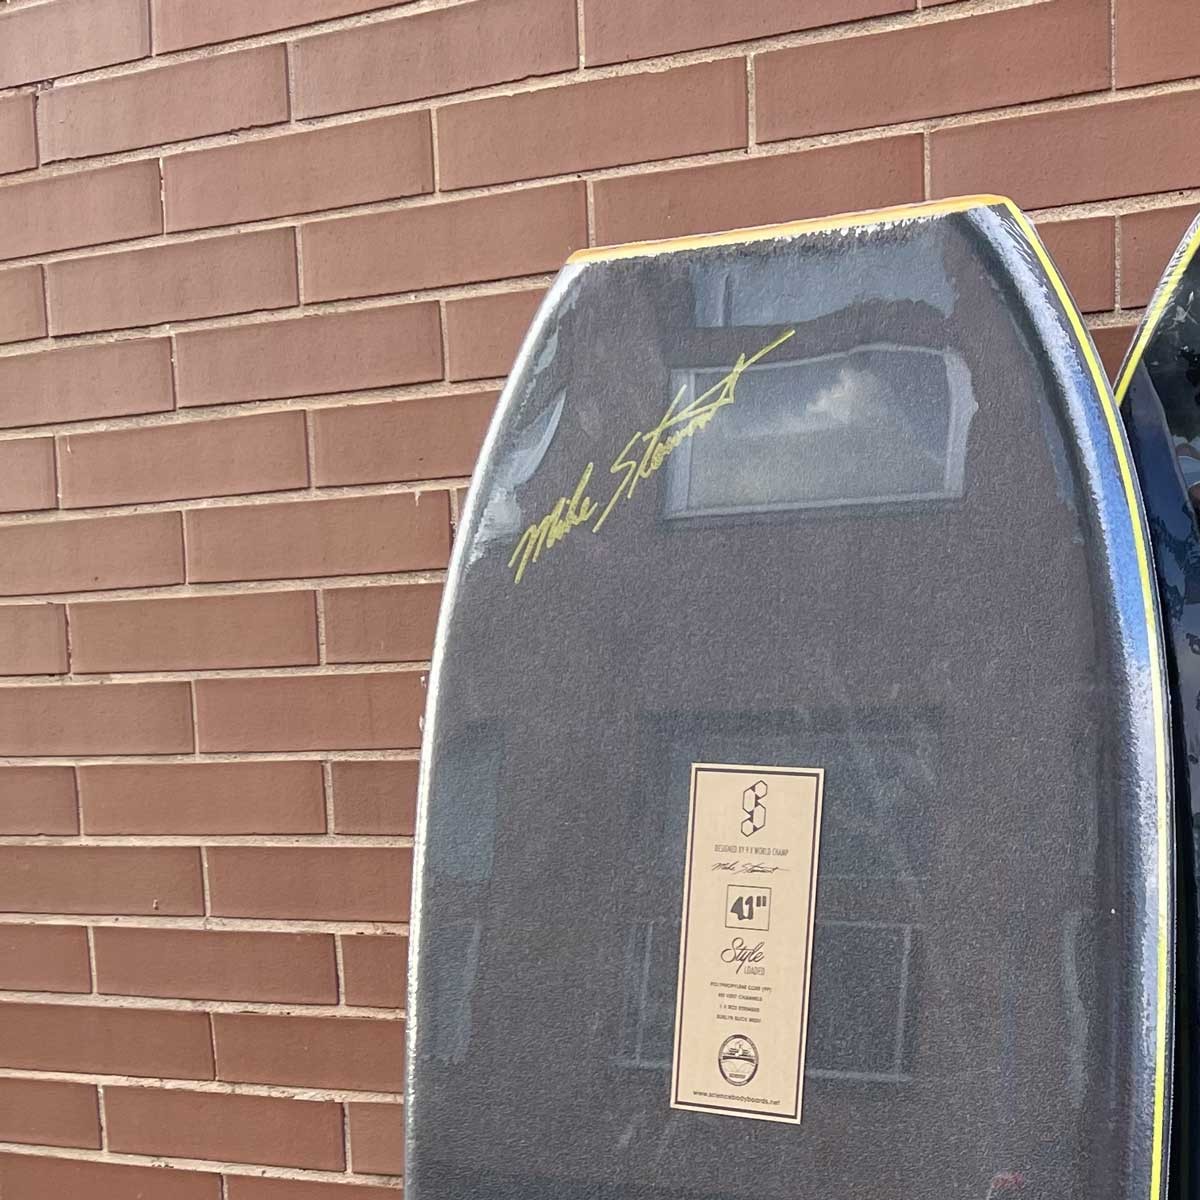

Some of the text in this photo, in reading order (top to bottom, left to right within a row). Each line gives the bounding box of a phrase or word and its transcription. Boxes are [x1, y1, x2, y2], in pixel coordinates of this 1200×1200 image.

[508, 462, 598, 584] Mike
[730, 895, 767, 920] 41"
[720, 937, 765, 975] Style
